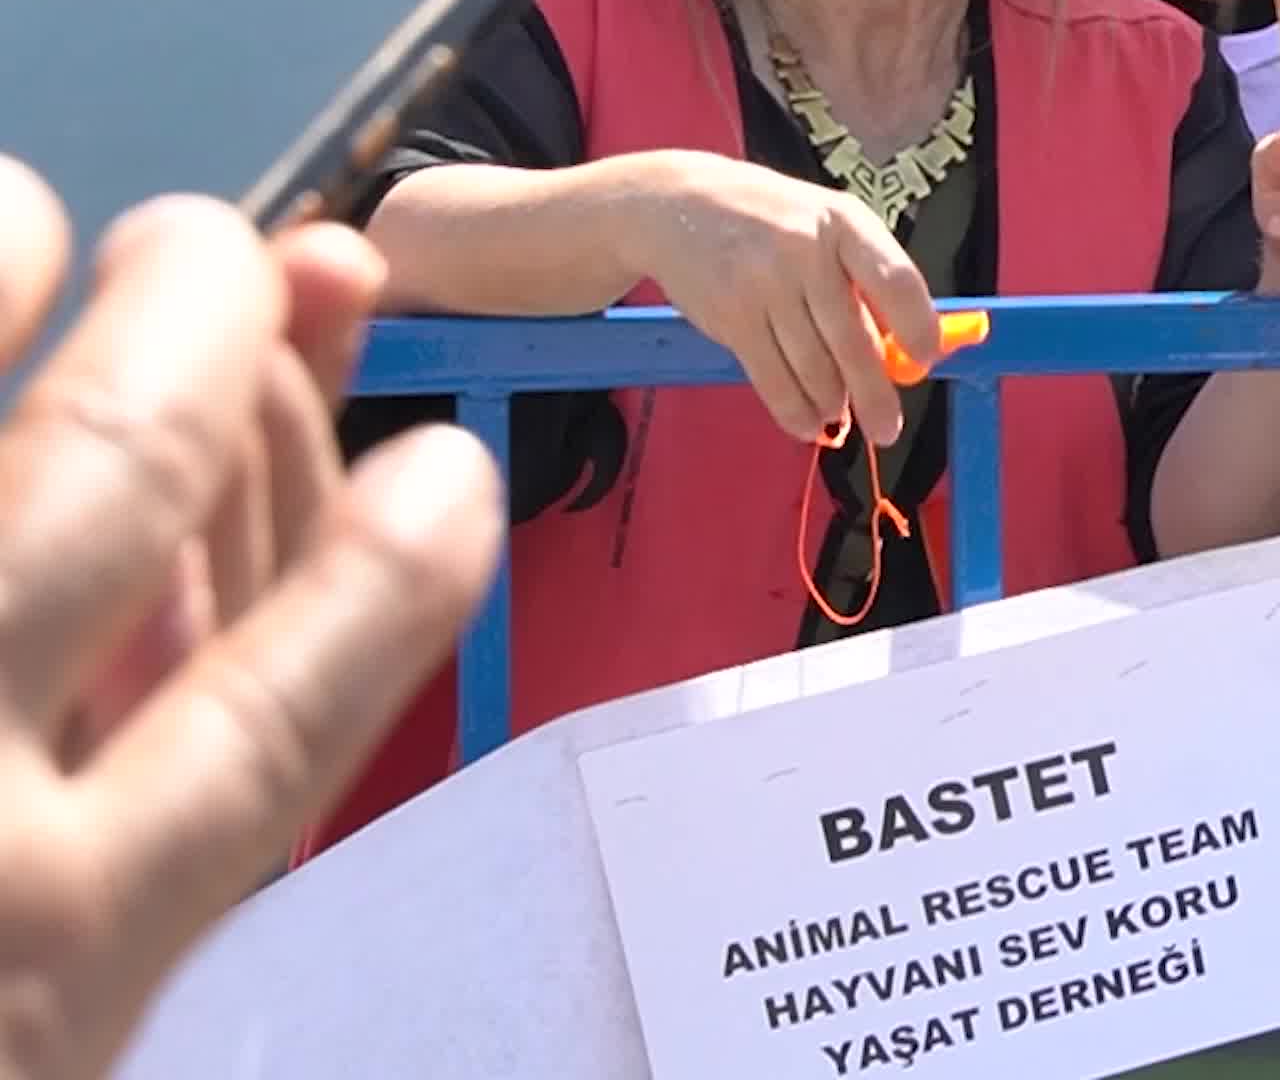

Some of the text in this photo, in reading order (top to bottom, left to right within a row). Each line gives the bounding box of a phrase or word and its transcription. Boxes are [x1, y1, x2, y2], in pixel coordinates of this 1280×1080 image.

[819, 742, 1117, 863] BASTET
[722, 809, 1261, 978] ANİMAL RESCUE TEAM
[763, 875, 1240, 1030] HAYVANI SEV KORU
[822, 938, 1208, 1078] YAŞAT DERNEĞİ
